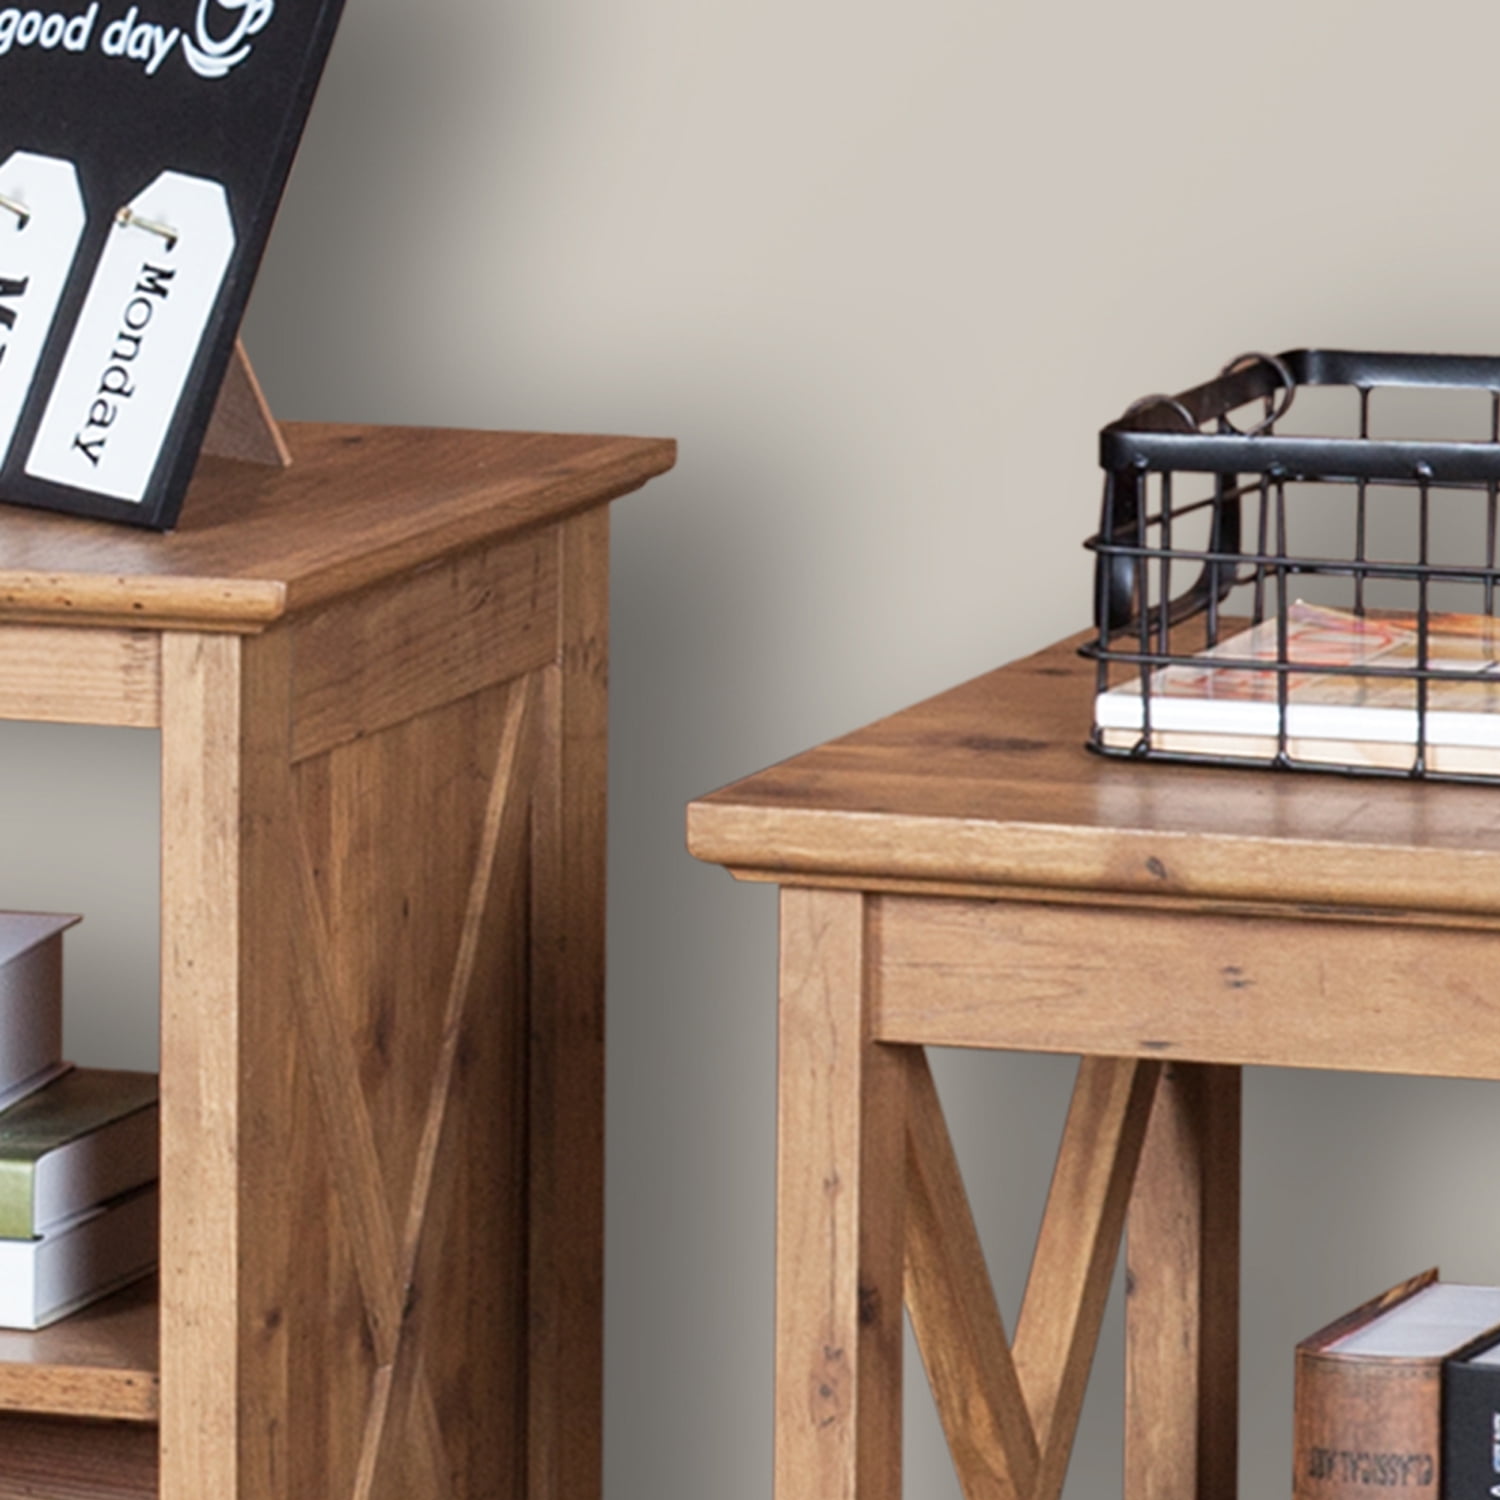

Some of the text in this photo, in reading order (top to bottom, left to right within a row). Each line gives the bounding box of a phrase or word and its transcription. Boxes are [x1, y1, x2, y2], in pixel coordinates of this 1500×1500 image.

[0, 2, 180, 74] good day
[71, 262, 176, 467] Monday
